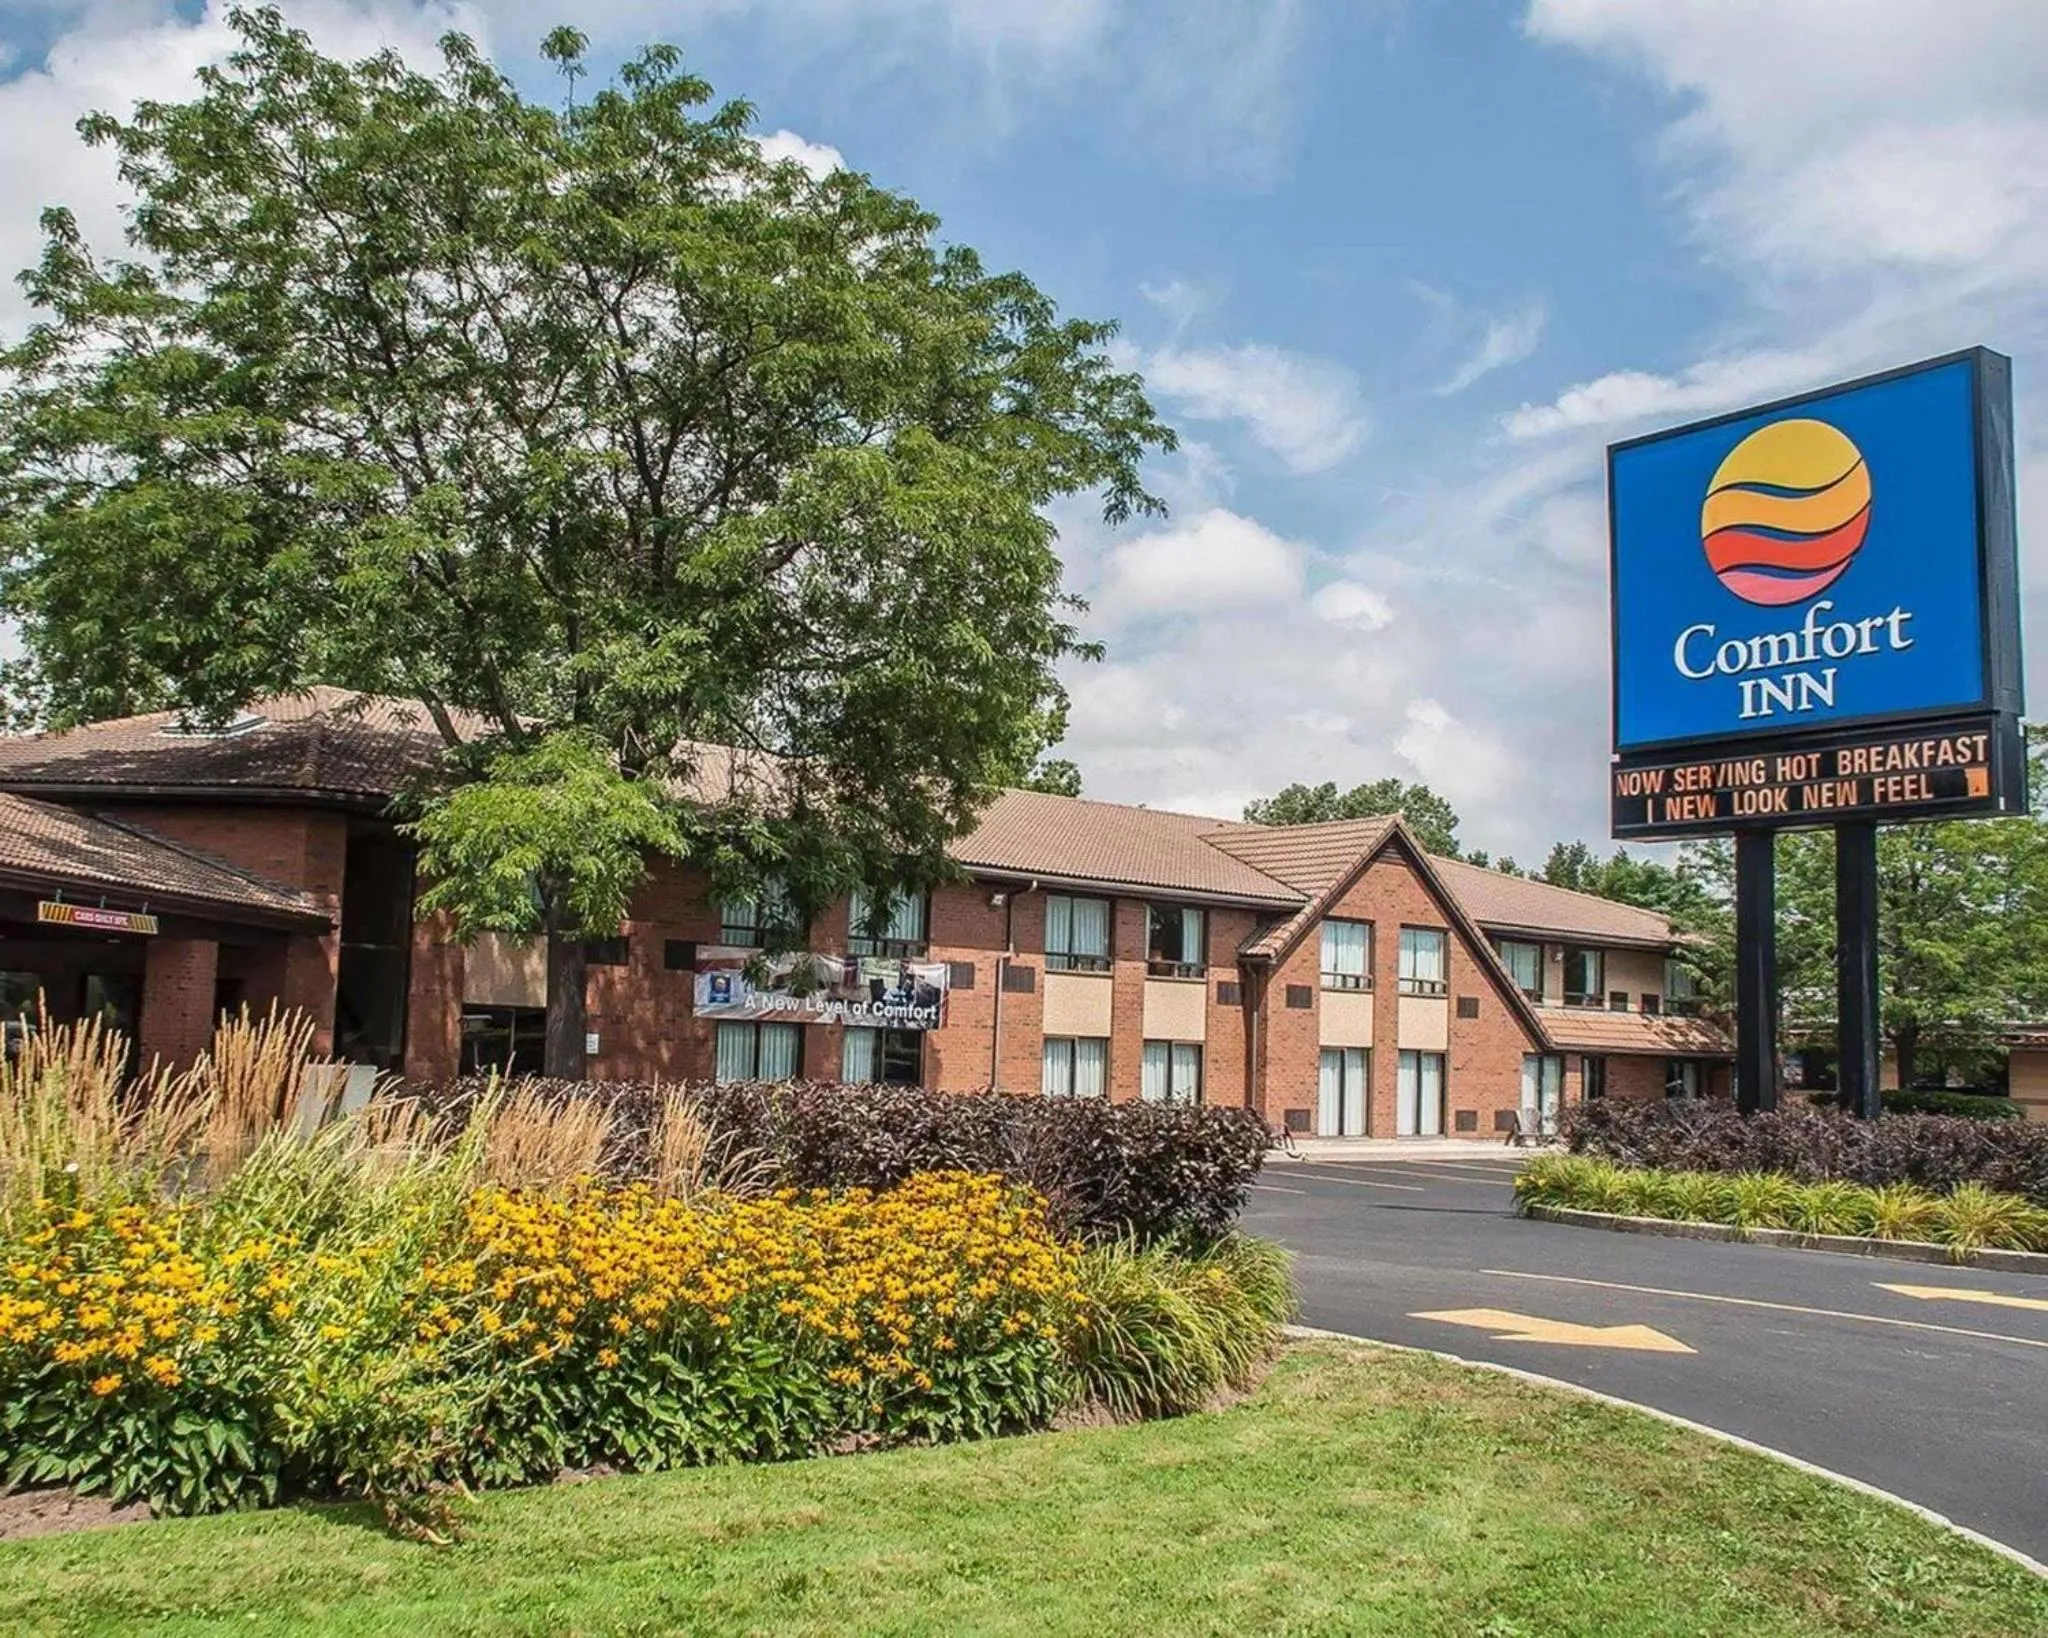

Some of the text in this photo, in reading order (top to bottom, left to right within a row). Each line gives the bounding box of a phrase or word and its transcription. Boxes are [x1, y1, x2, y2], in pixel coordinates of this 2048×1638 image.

[1674, 600, 1914, 679] Comfort
[1739, 668, 1838, 719] INN
[1616, 735, 1988, 796] NOW SERVING HOT BREAKFAST
[1665, 793, 1717, 821] NEW
[1733, 786, 1789, 816] LOOK
[1803, 780, 1858, 810] NEW
[1873, 773, 1934, 804] FEEL
[744, 994, 757, 1010] A
[762, 994, 800, 1012] New
[805, 996, 850, 1015] Level
[852, 1000, 869, 1015] of
[872, 1001, 937, 1020] Comfort
